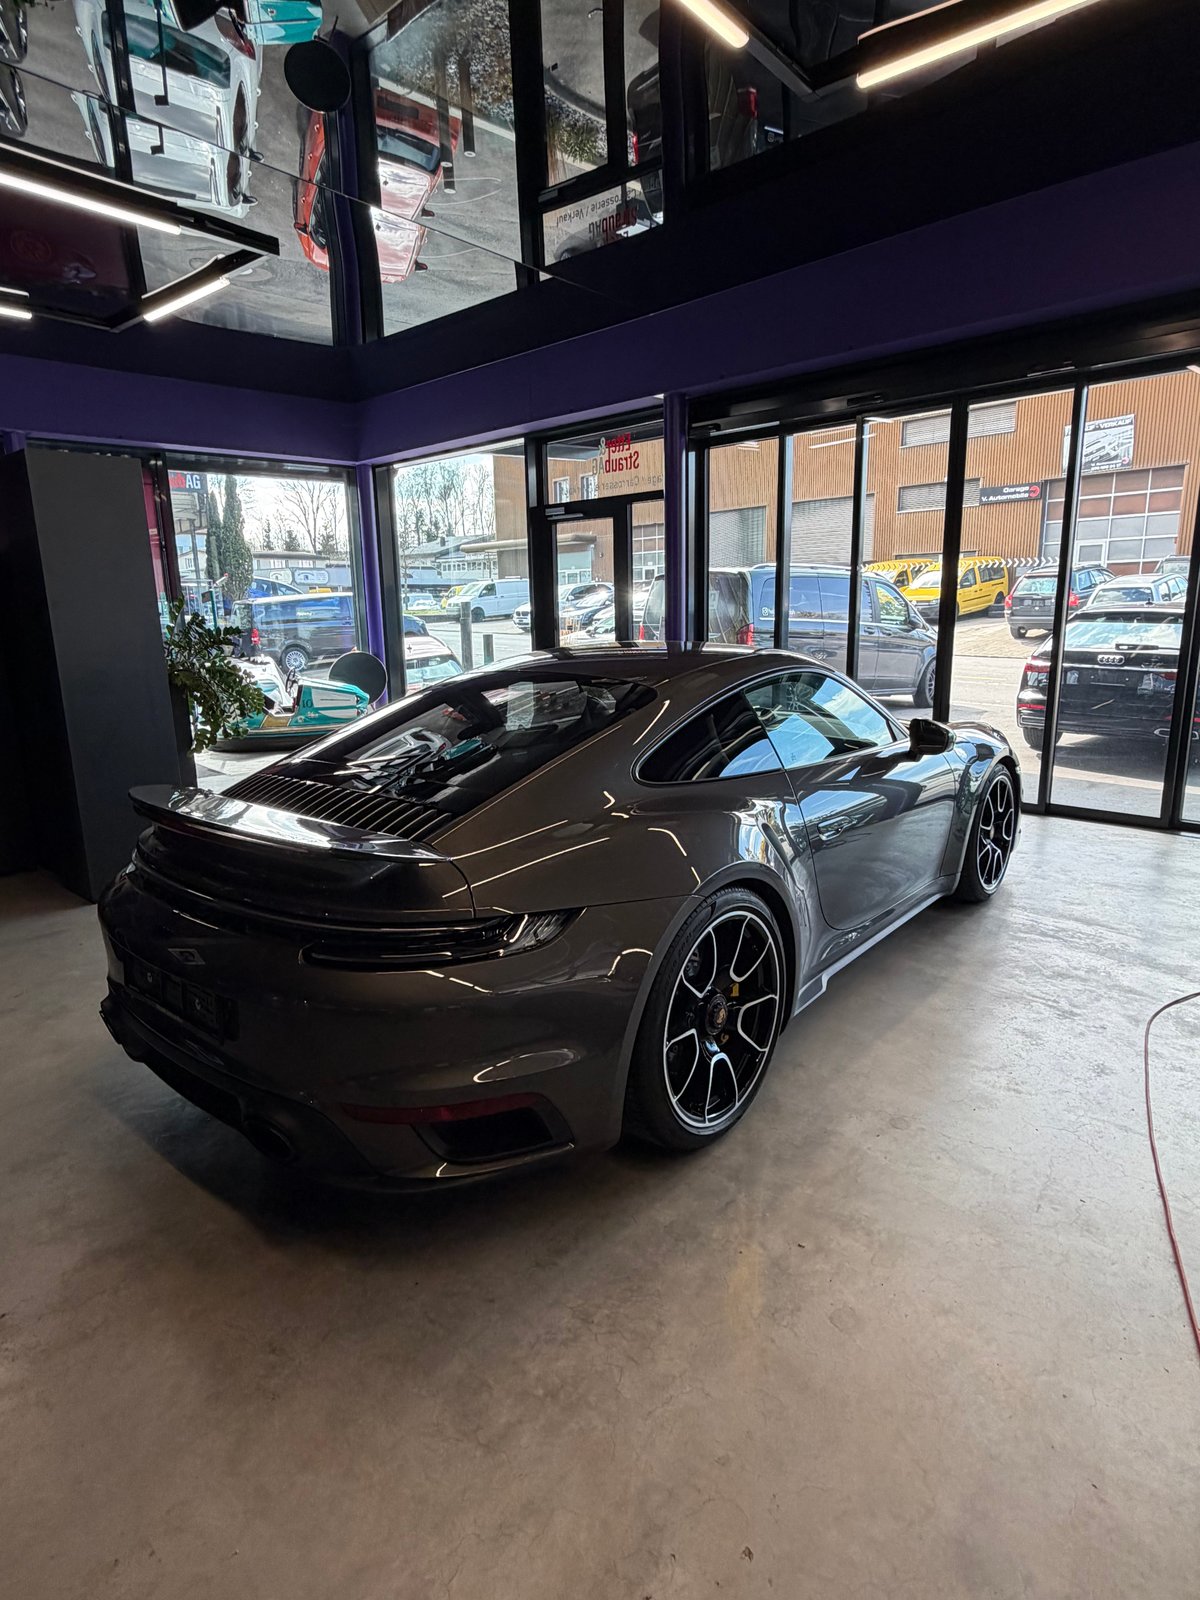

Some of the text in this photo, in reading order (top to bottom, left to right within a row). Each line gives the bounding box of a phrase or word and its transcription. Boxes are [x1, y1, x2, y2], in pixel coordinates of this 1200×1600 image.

[556, 207, 585, 228] Verkauf
[186, 474, 201, 489] AG
[1003, 485, 1030, 493] Garage
[989, 492, 1029, 502] Automobile
[302, 698, 314, 709] 10
